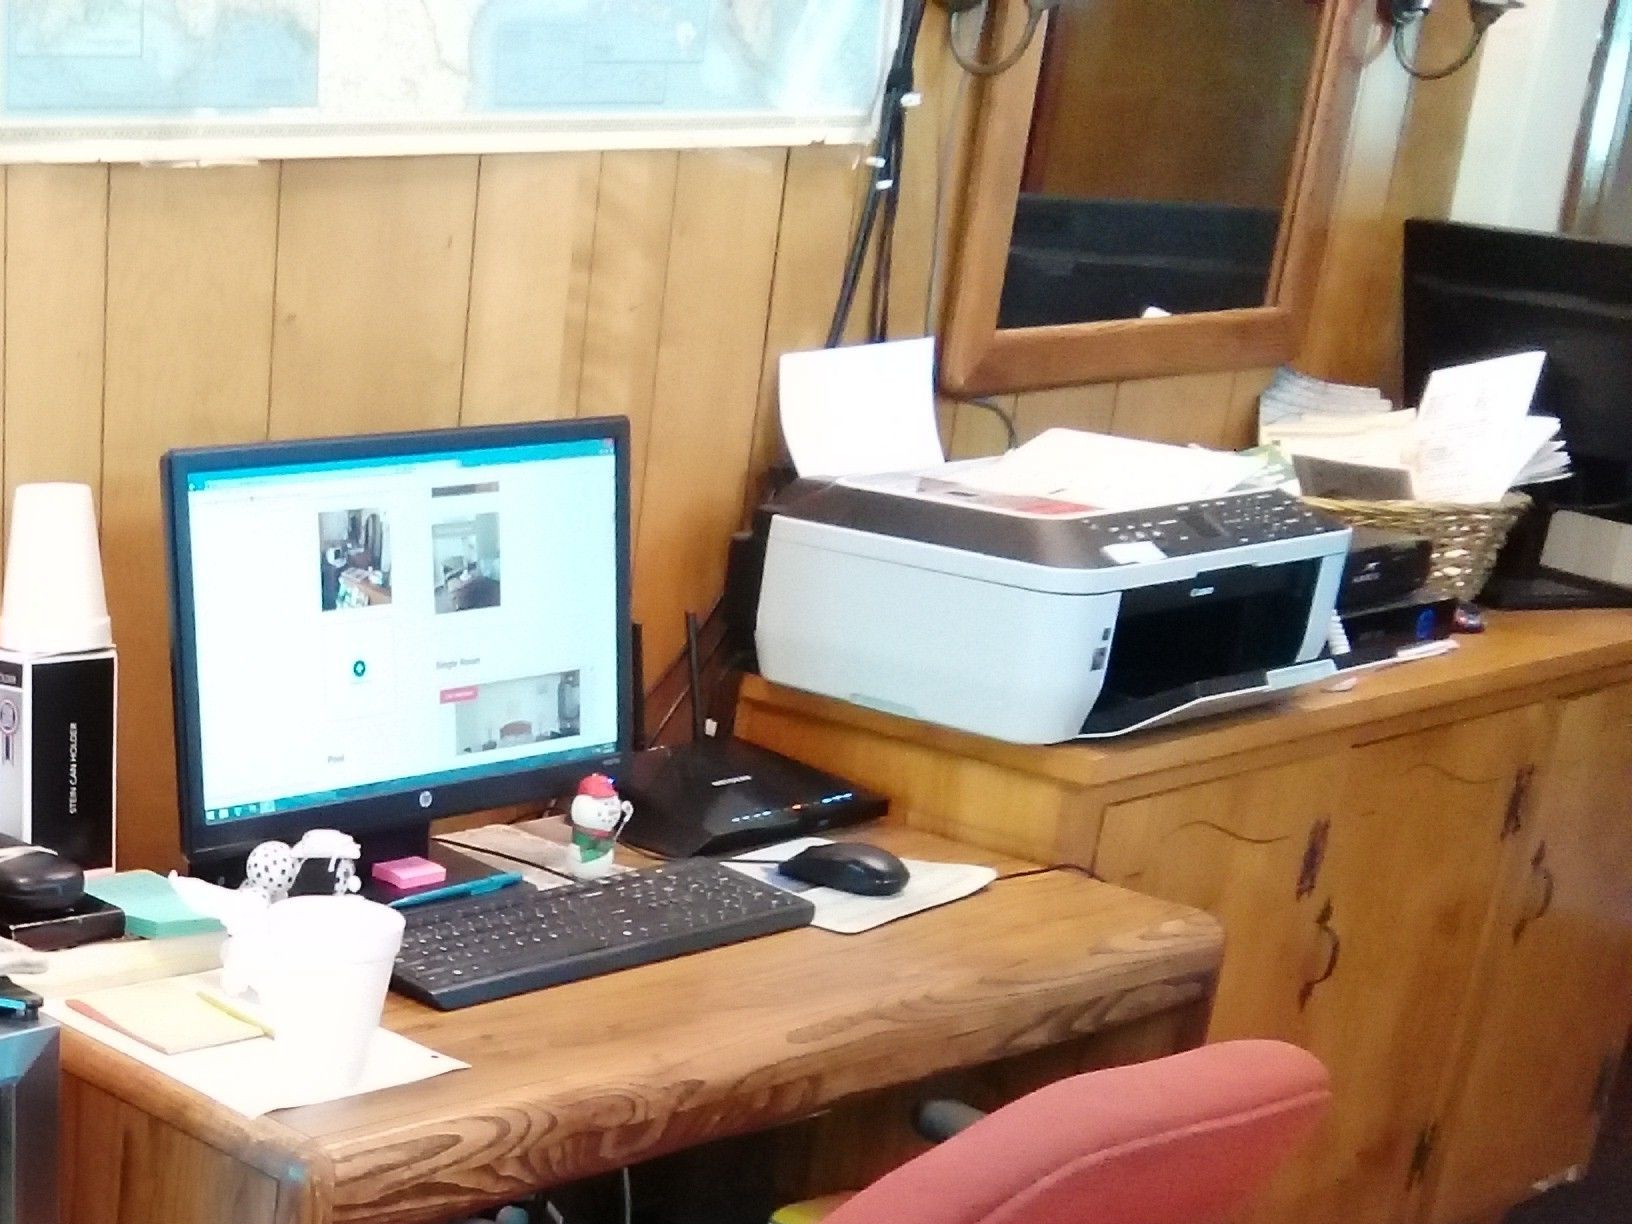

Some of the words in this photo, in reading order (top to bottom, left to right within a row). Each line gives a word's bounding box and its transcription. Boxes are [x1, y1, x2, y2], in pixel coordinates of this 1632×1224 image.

[69, 722, 78, 763] HOLDER
[69, 763, 78, 786] CAN
[69, 787, 78, 815] STEIN
